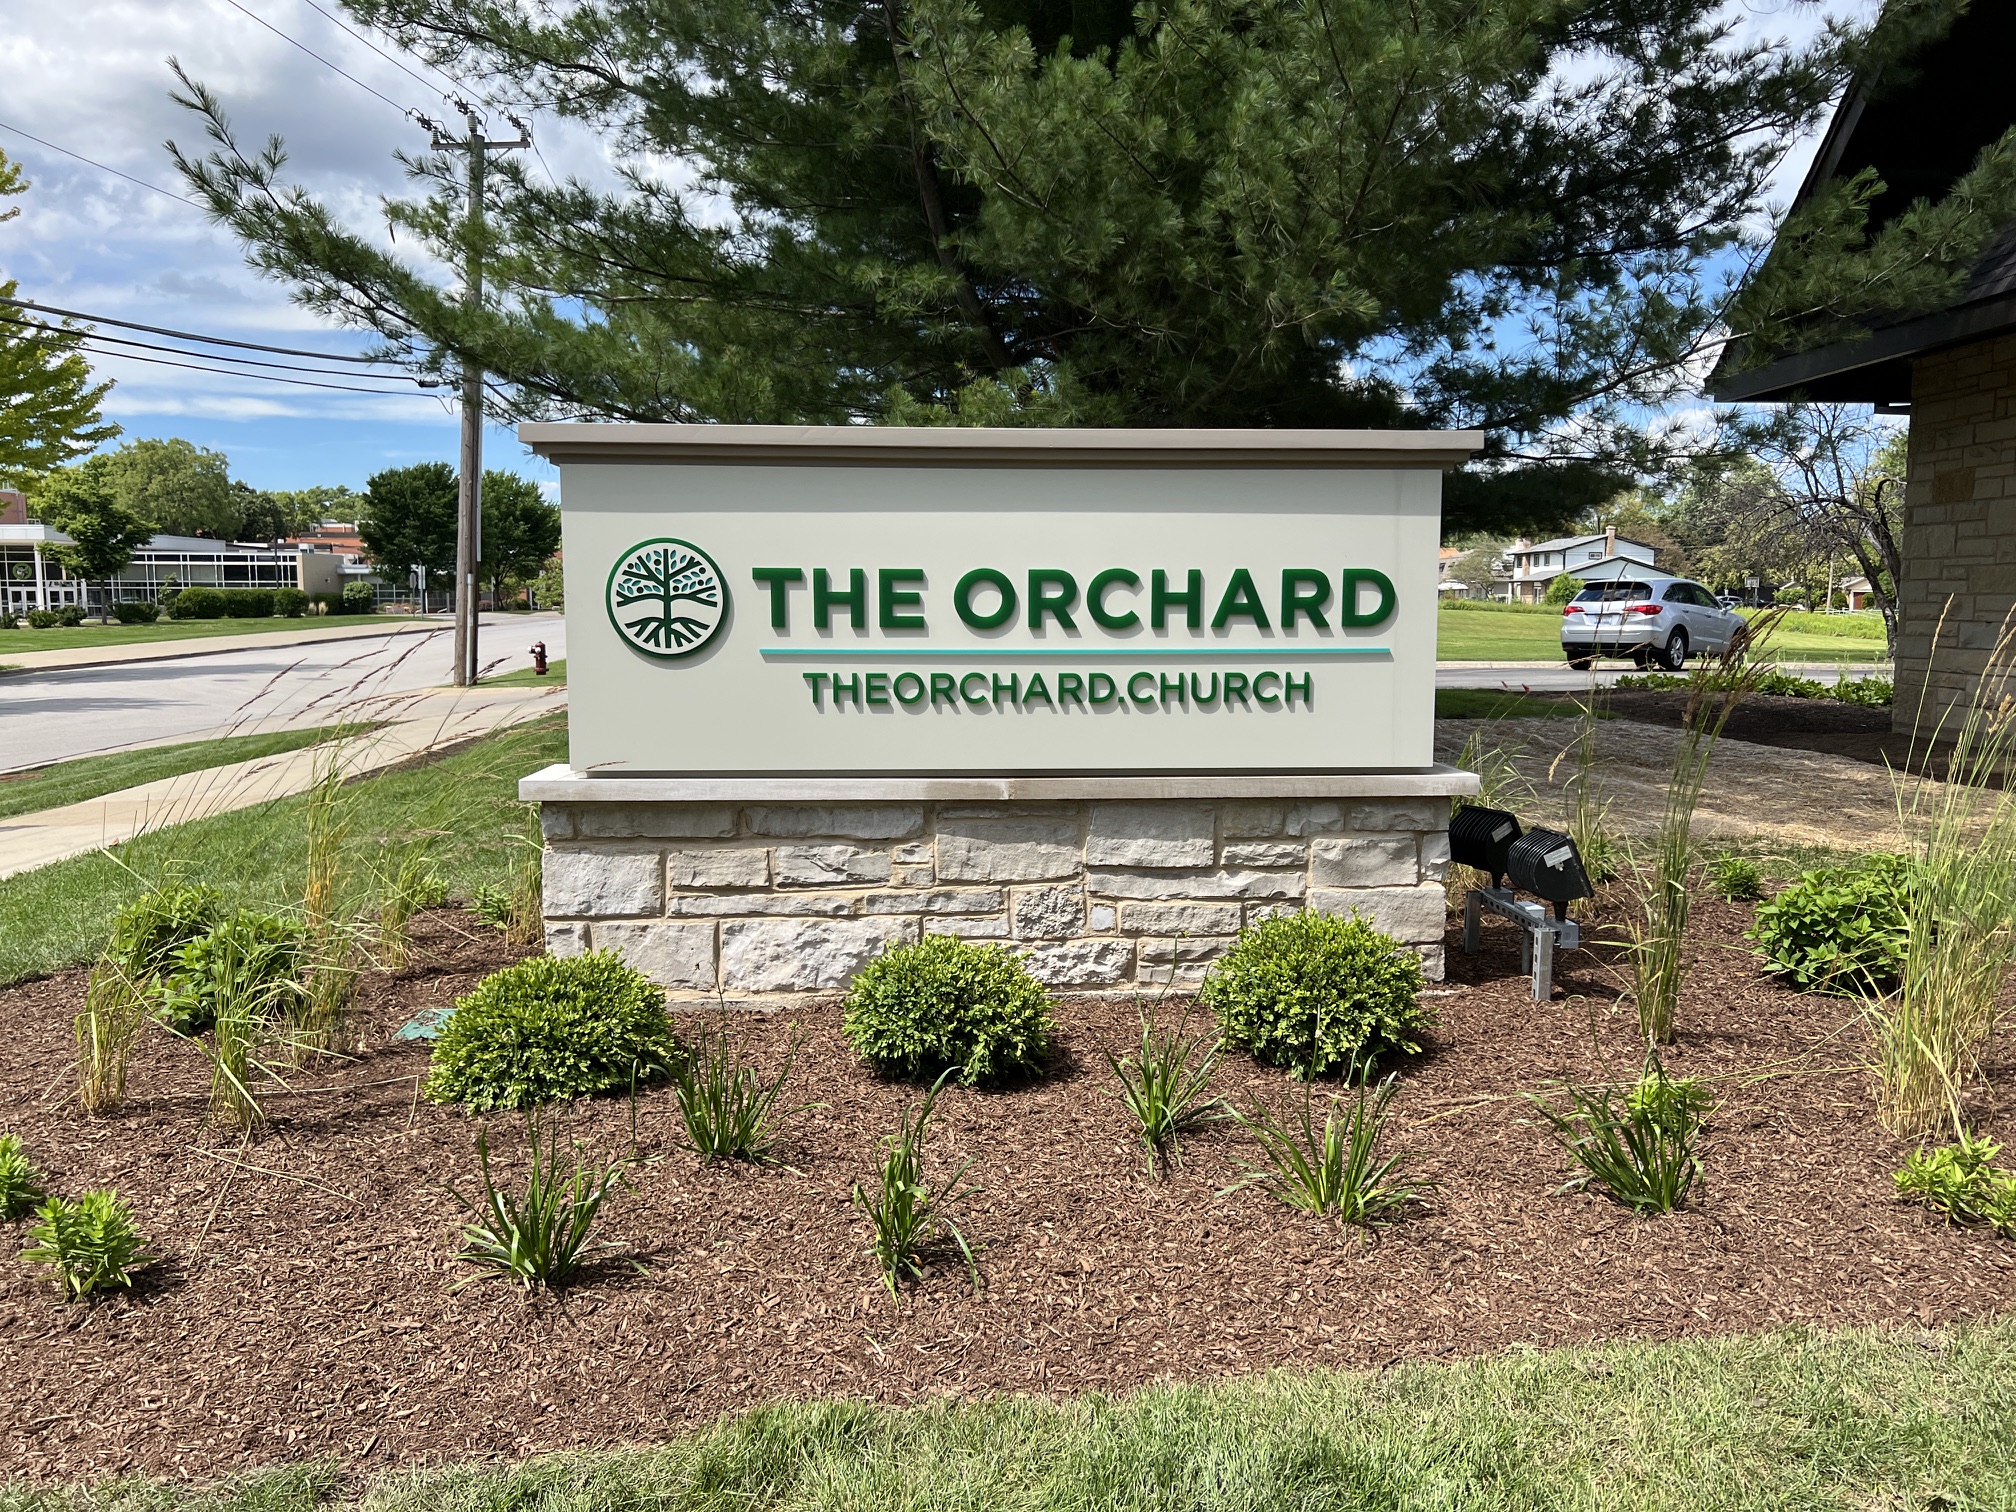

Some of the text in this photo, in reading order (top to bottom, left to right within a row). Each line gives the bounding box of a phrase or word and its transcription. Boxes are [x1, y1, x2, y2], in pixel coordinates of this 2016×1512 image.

[752, 567, 1397, 630] THE ORCHARD
[802, 671, 1312, 705] THEORCHARD.CHURCH
